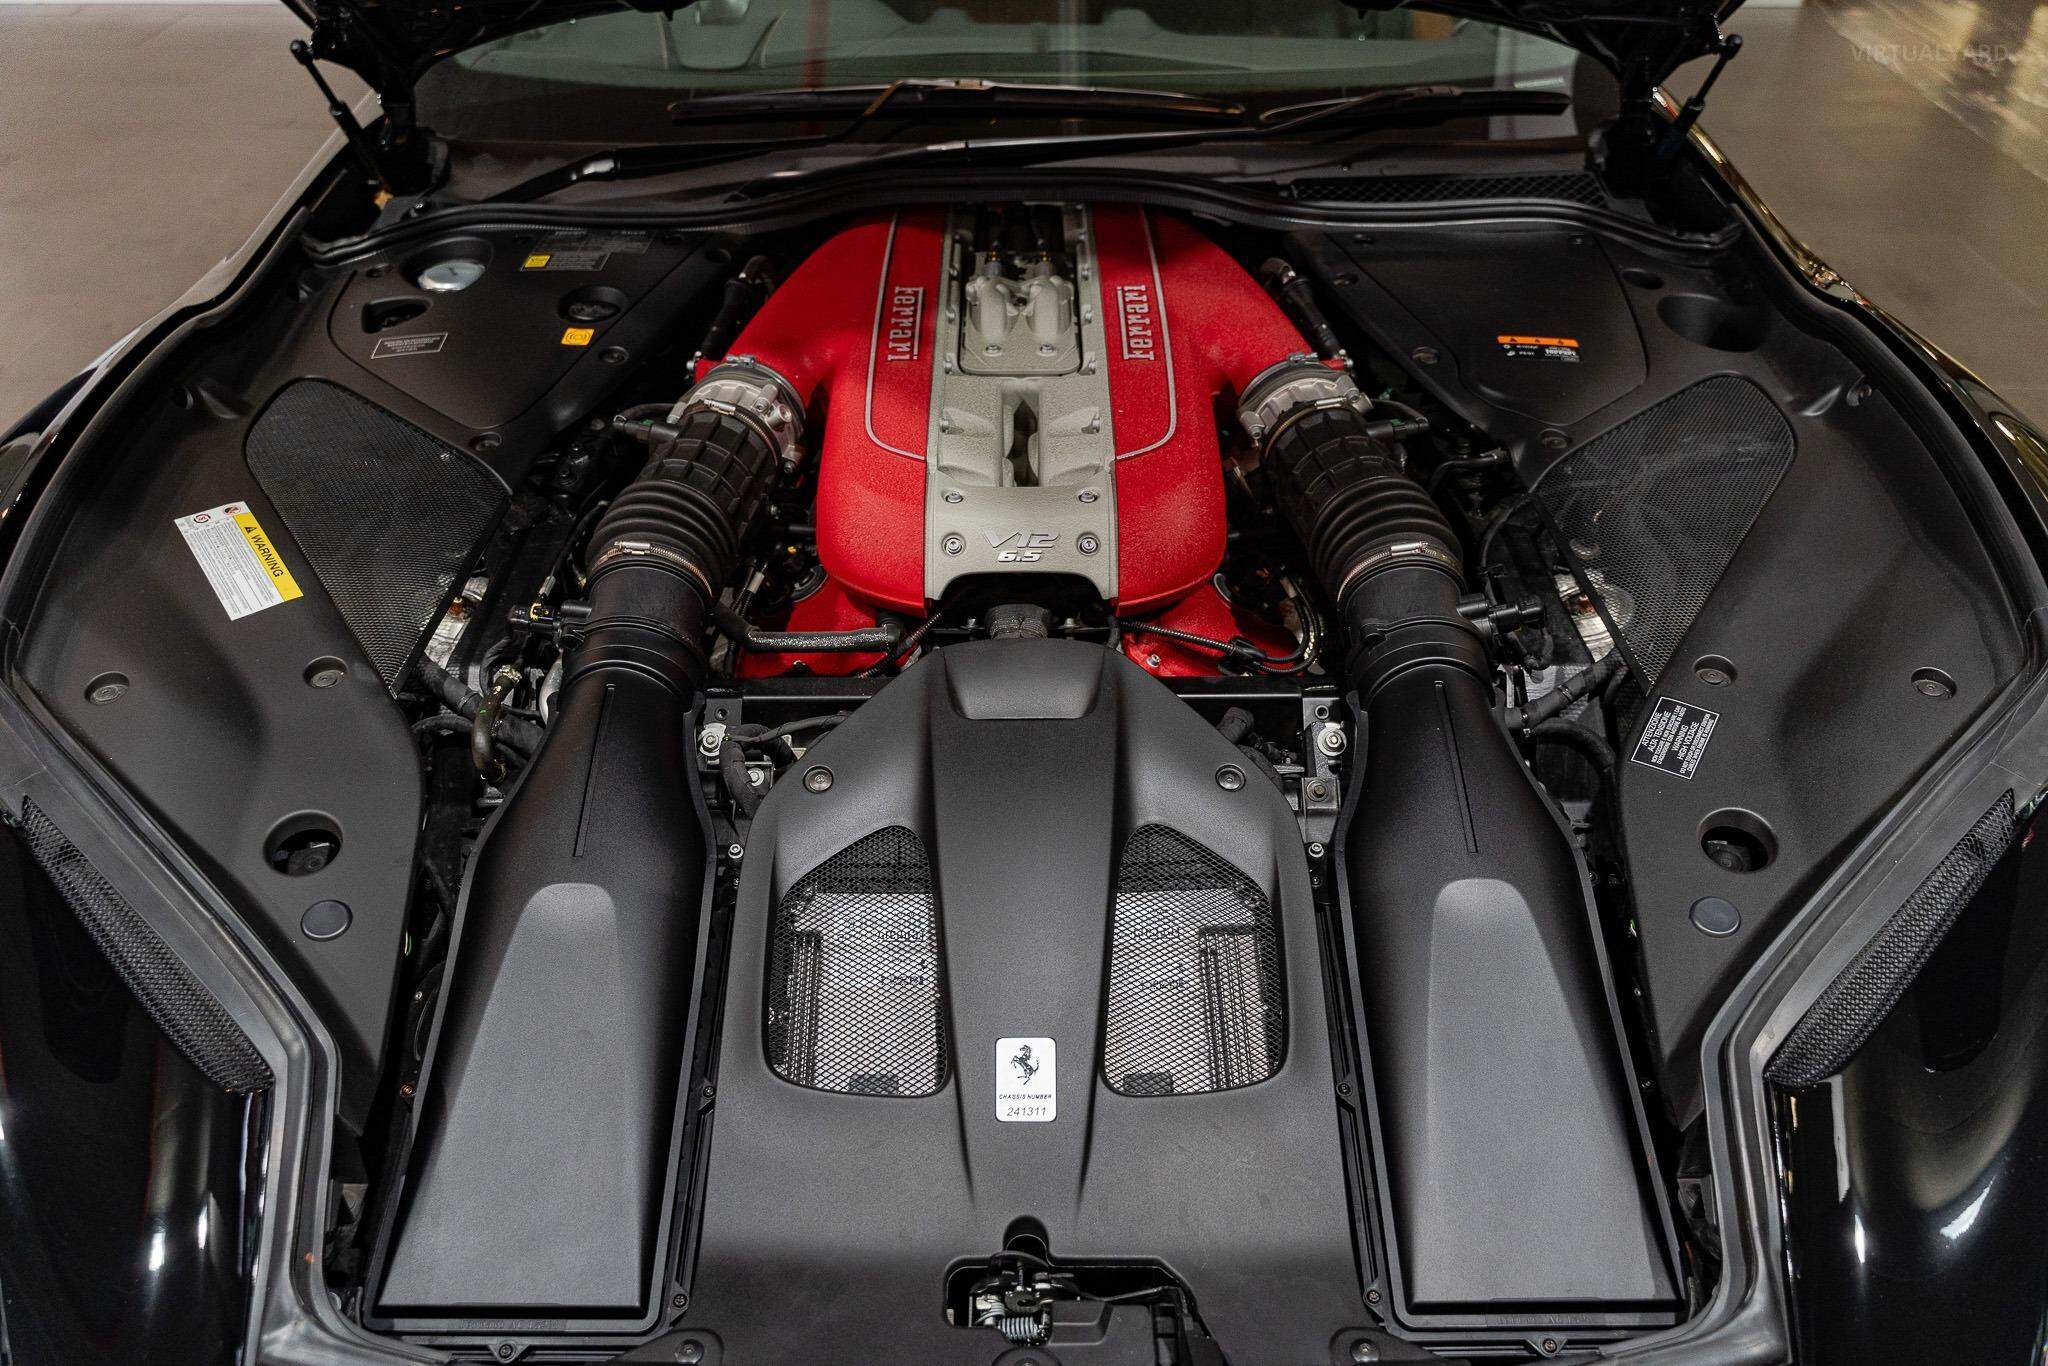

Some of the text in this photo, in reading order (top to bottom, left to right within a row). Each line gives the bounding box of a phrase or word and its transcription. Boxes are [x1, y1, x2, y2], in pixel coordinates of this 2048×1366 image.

[887, 286, 924, 361] Ferrari
[1117, 285, 1155, 360] Ferrari
[251, 534, 284, 578] WARNING
[981, 527, 1060, 548] V12
[998, 549, 1043, 562] 6.5
[1647, 710, 1671, 752] ALTA TENSIONE
[1677, 721, 1699, 760] HIGH VOLTAGE
[1007, 1106, 1046, 1117] 241311
